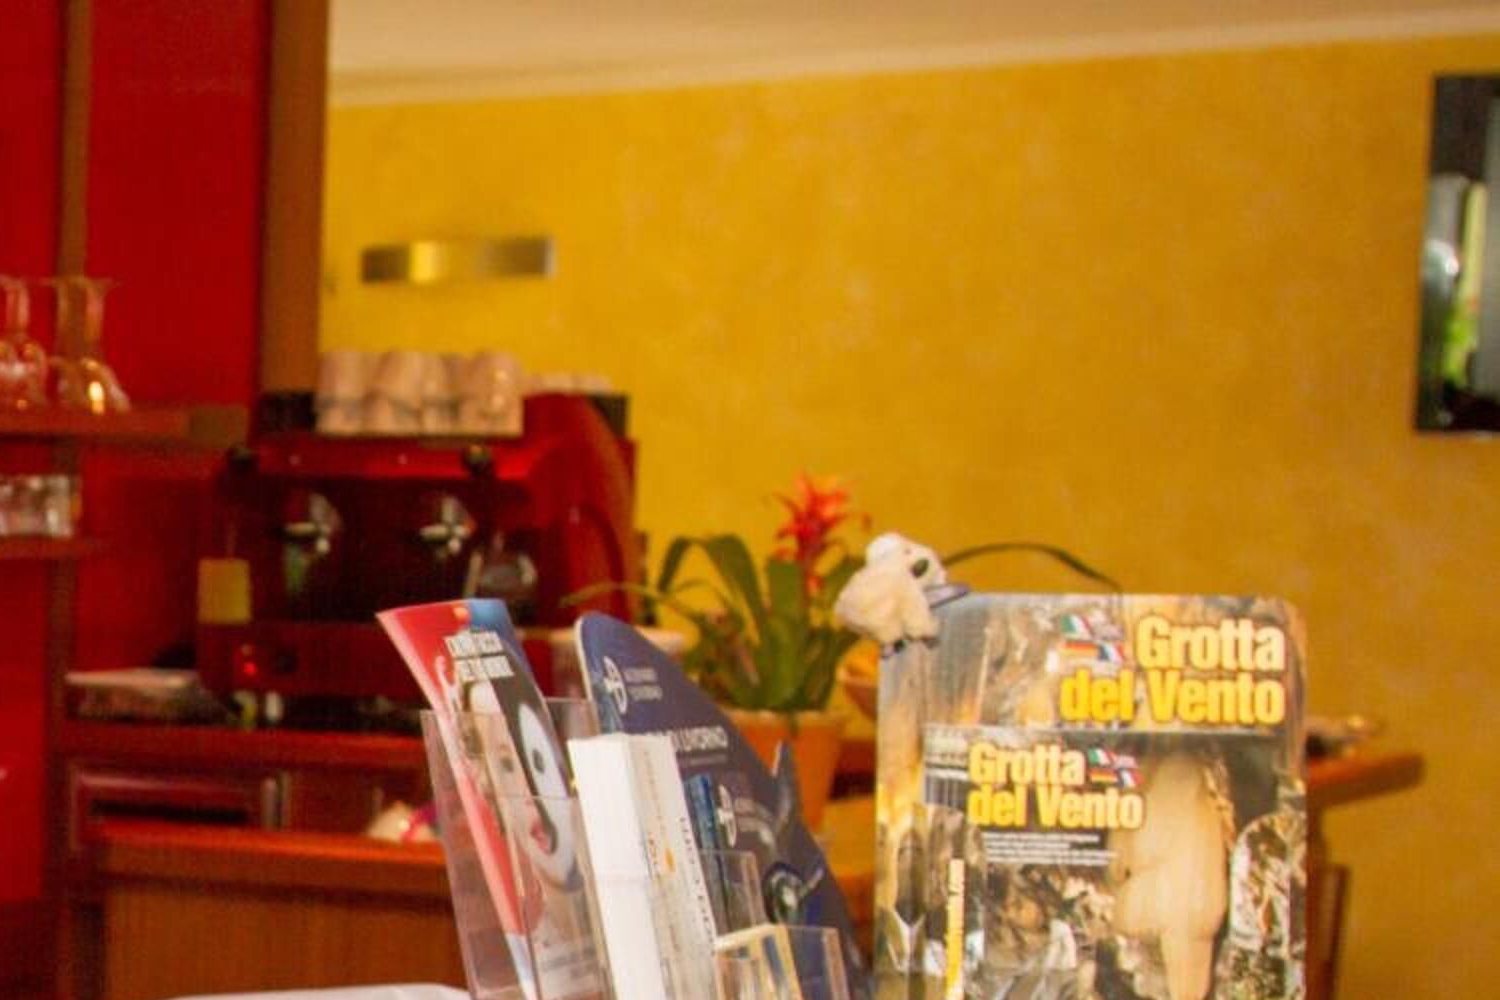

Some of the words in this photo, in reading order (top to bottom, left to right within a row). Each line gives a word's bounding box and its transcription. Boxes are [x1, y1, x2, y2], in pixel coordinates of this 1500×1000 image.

[1136, 615, 1286, 671] Grotta
[1059, 668, 1133, 722] del
[1150, 670, 1286, 725] Vento
[968, 740, 1086, 787] Grotta
[967, 783, 1027, 829] del
[1035, 784, 1145, 829] Vento
